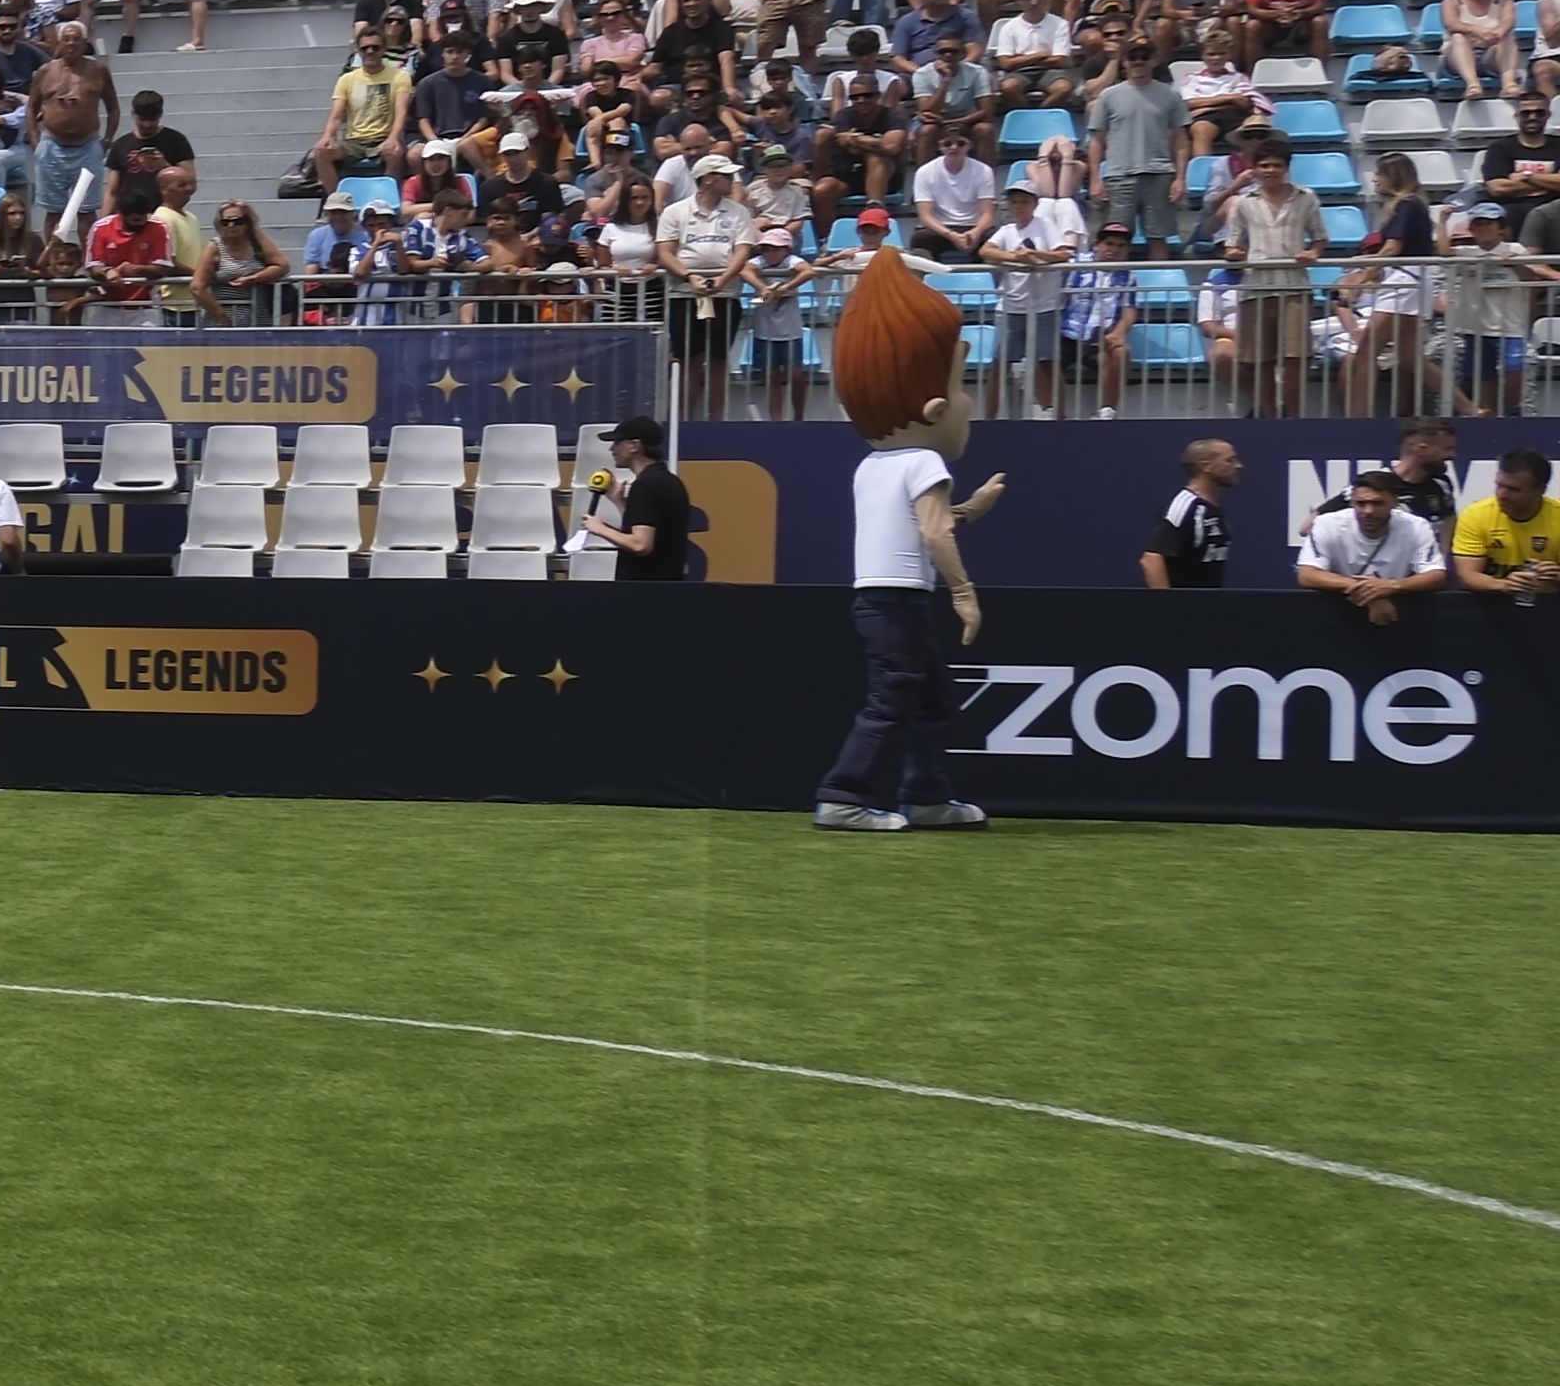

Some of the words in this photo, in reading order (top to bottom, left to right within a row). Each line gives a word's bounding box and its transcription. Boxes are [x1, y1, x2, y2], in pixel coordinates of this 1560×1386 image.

[180, 364, 349, 406] LEGENDS
[106, 647, 288, 694] LEGENDS
[947, 664, 1478, 764] zome
